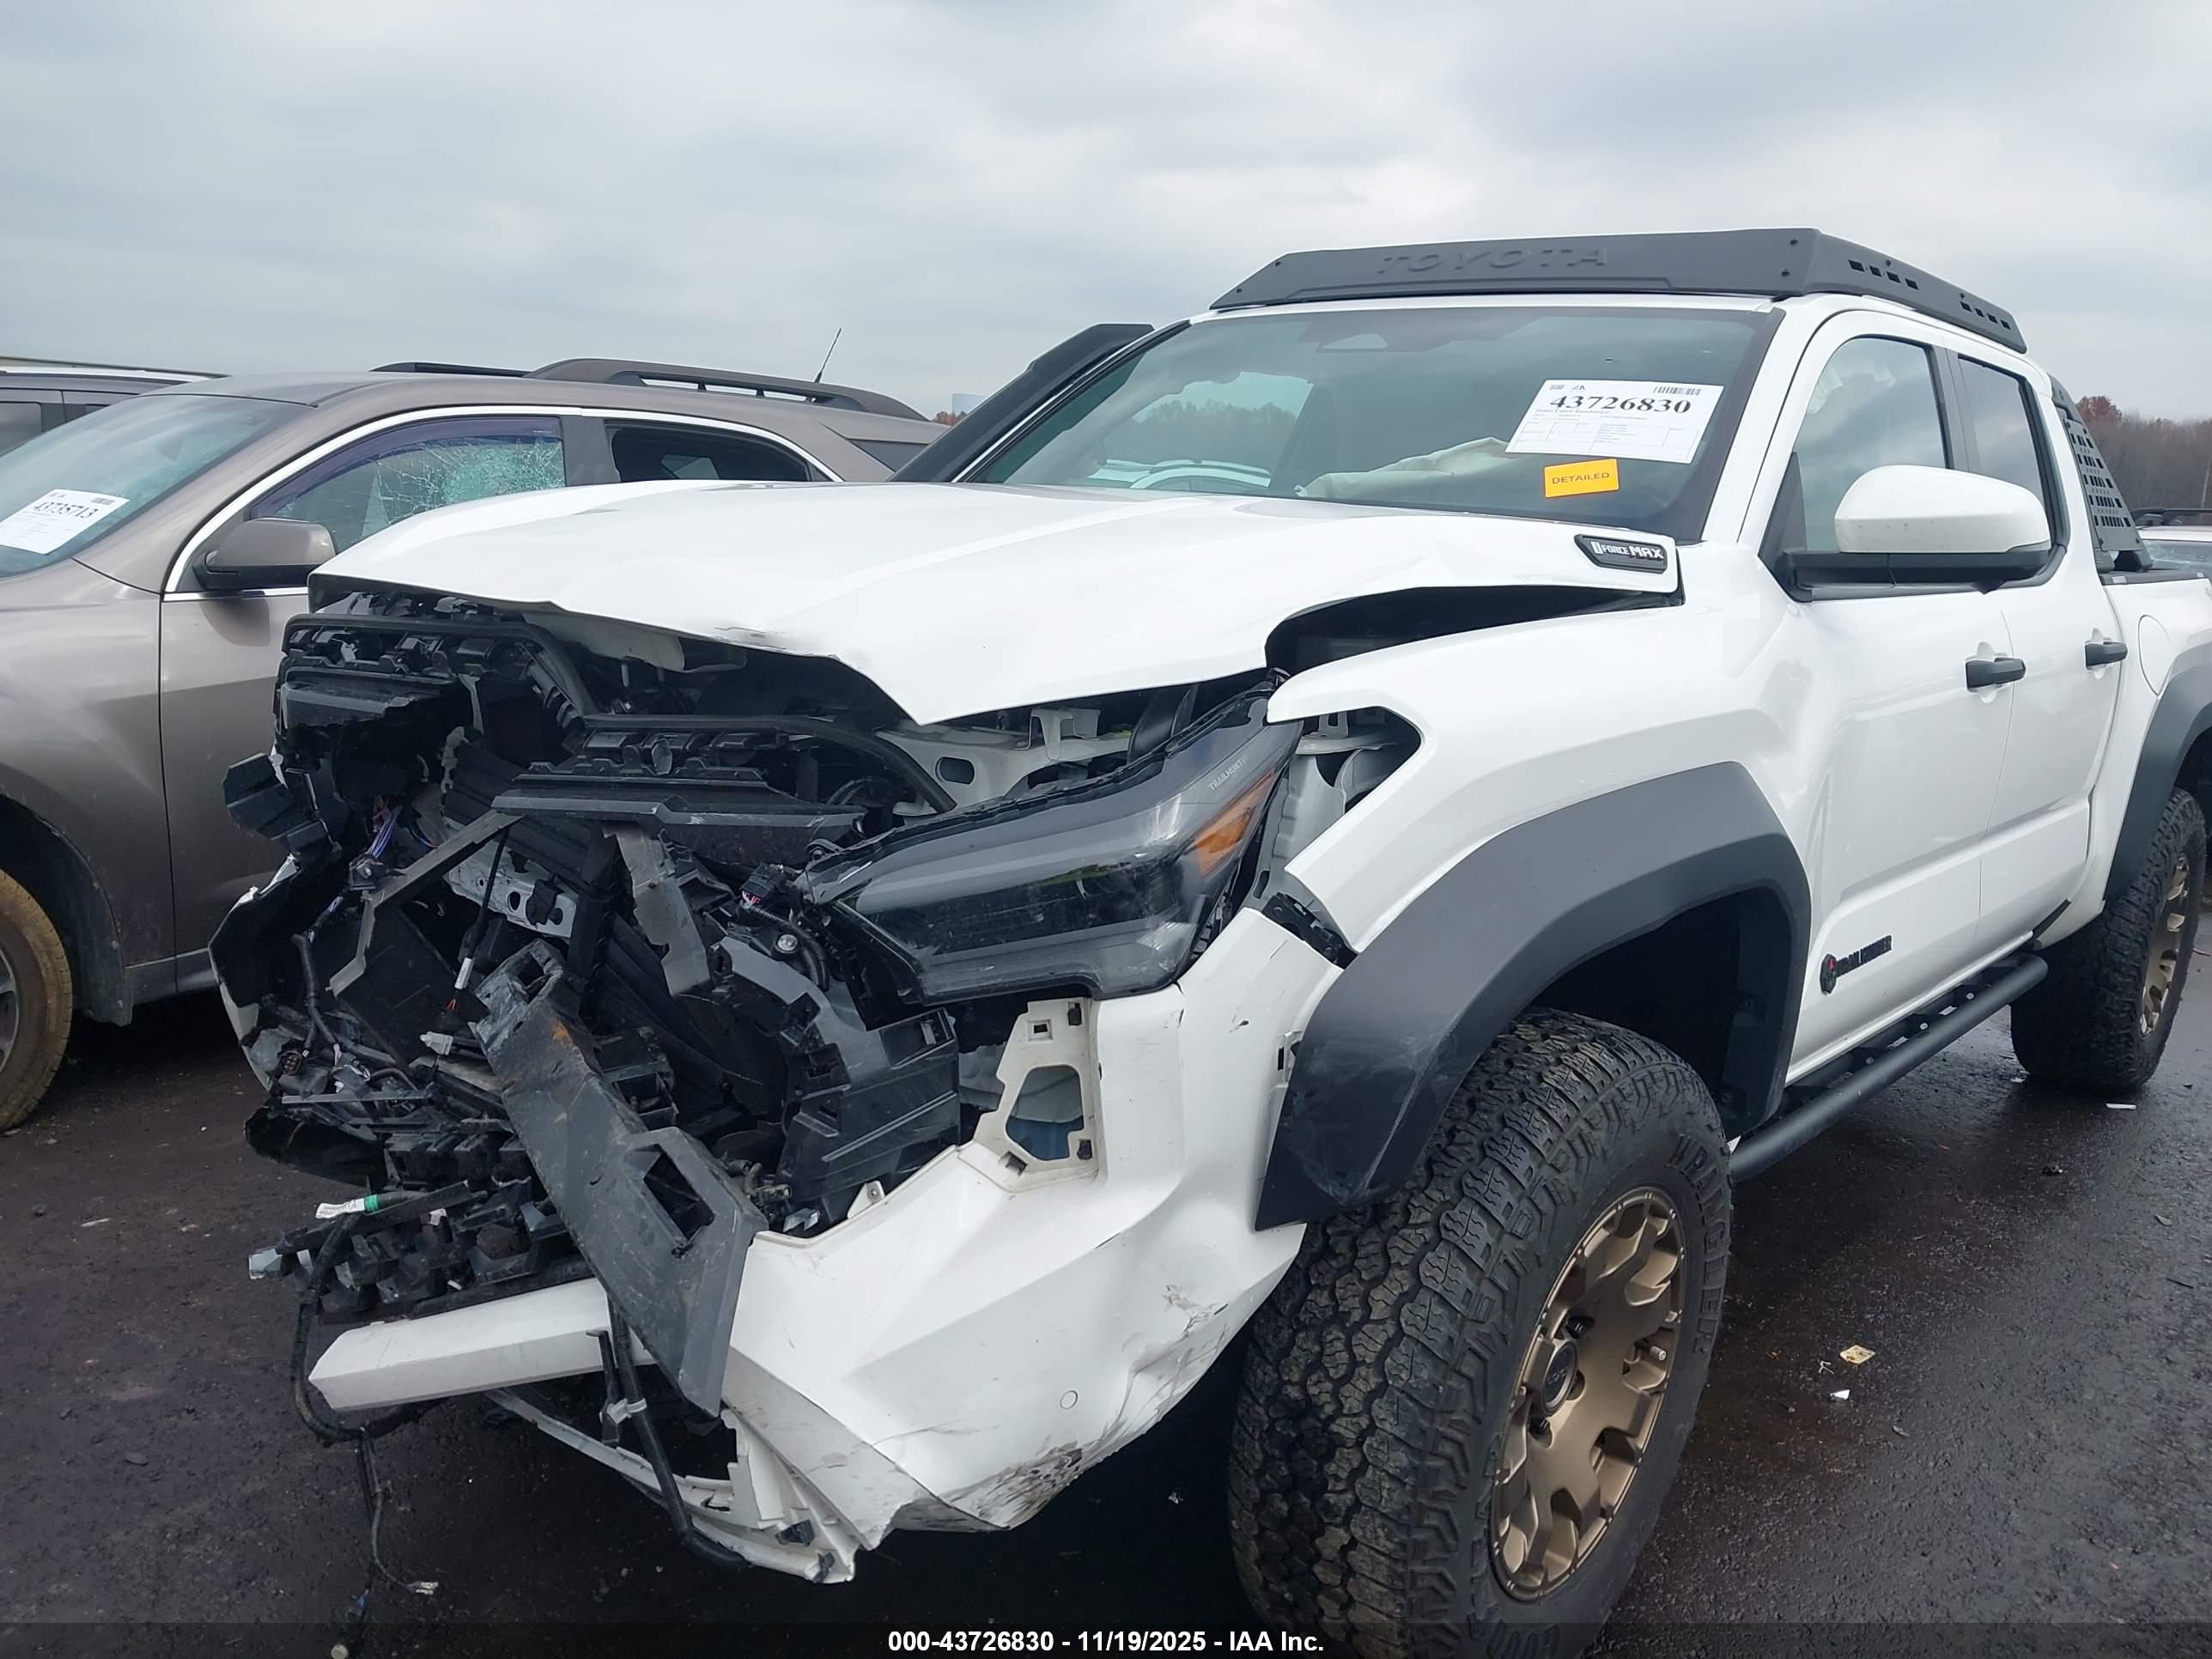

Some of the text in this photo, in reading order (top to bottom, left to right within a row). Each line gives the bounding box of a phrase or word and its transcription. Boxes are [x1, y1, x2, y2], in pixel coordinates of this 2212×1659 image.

[1376, 248, 1607, 274] TOYOTA
[1549, 395, 1692, 414] 43726830
[1552, 472, 1610, 484] DETAILED
